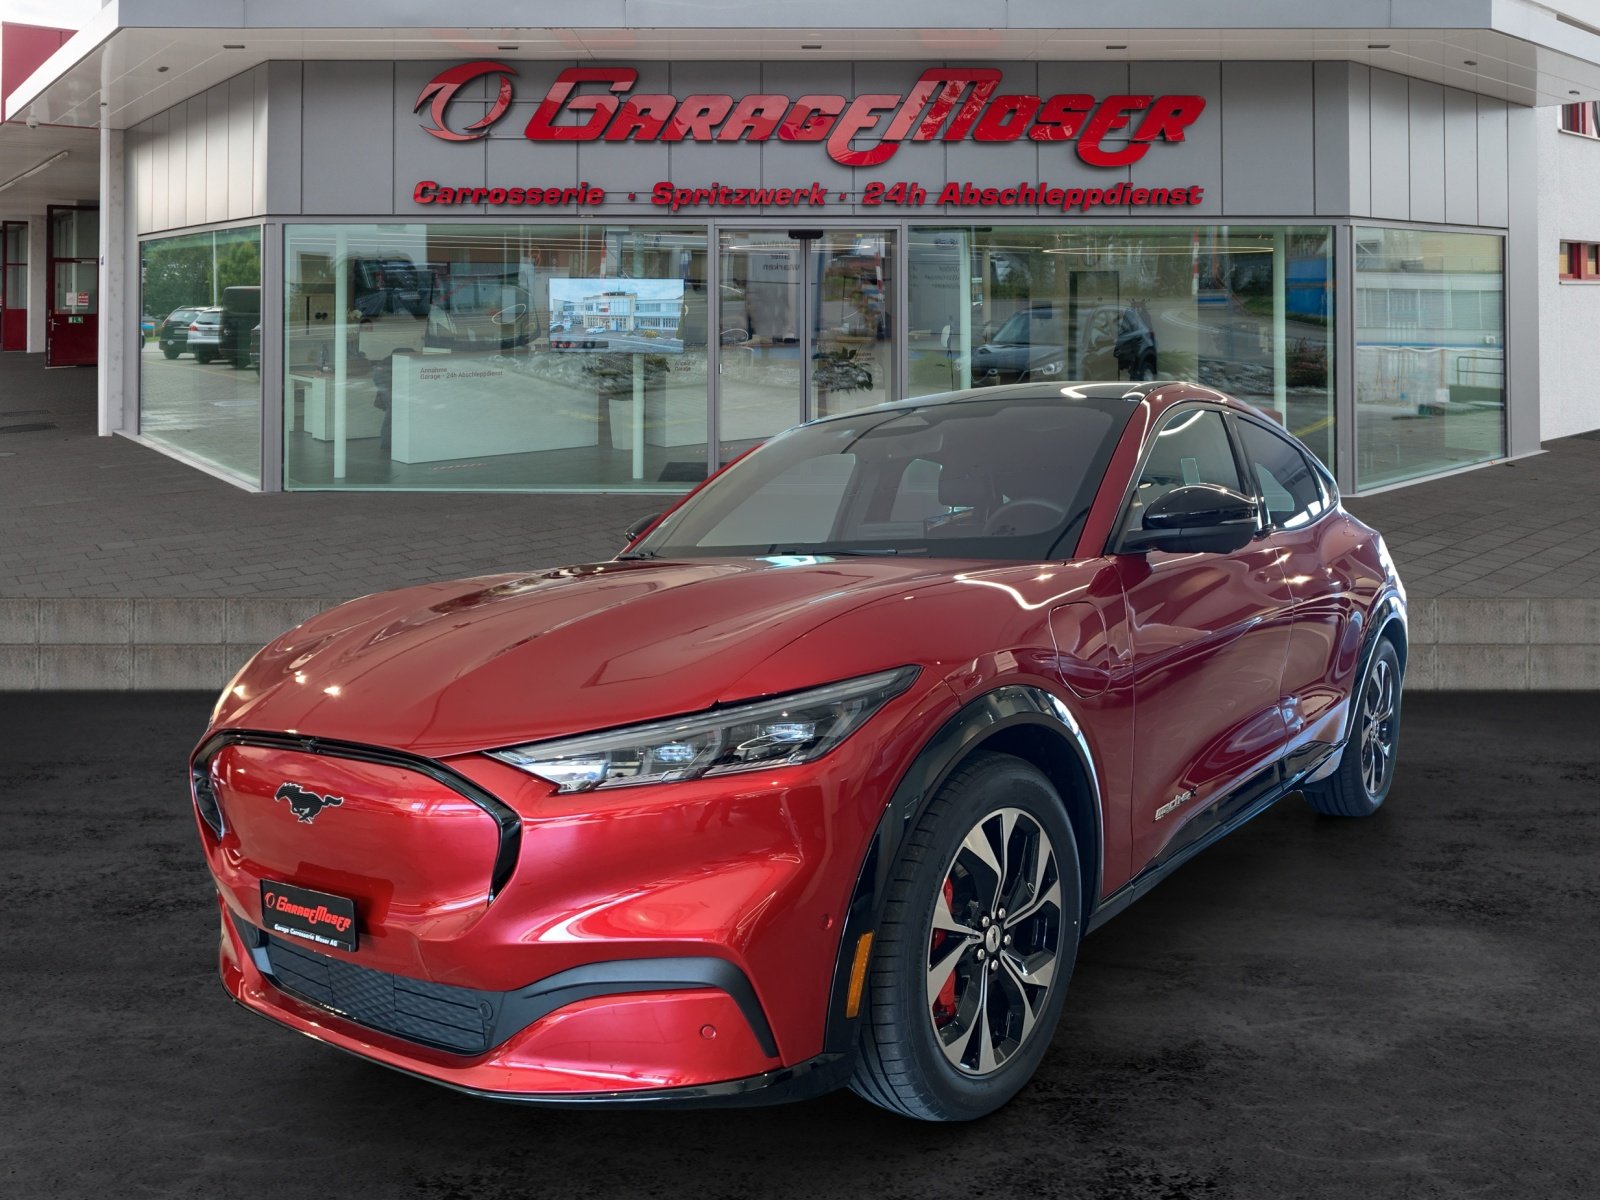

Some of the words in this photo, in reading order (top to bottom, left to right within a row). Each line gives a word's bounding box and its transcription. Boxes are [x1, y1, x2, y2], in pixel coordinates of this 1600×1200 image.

[413, 180, 606, 206] Carrosserie
[651, 181, 827, 211] Spritzwerk
[862, 182, 927, 206] 24h
[937, 182, 1204, 211] Abschleppdienst
[458, 370, 503, 378] Abschleppdienst
[329, 938, 338, 947] AG
